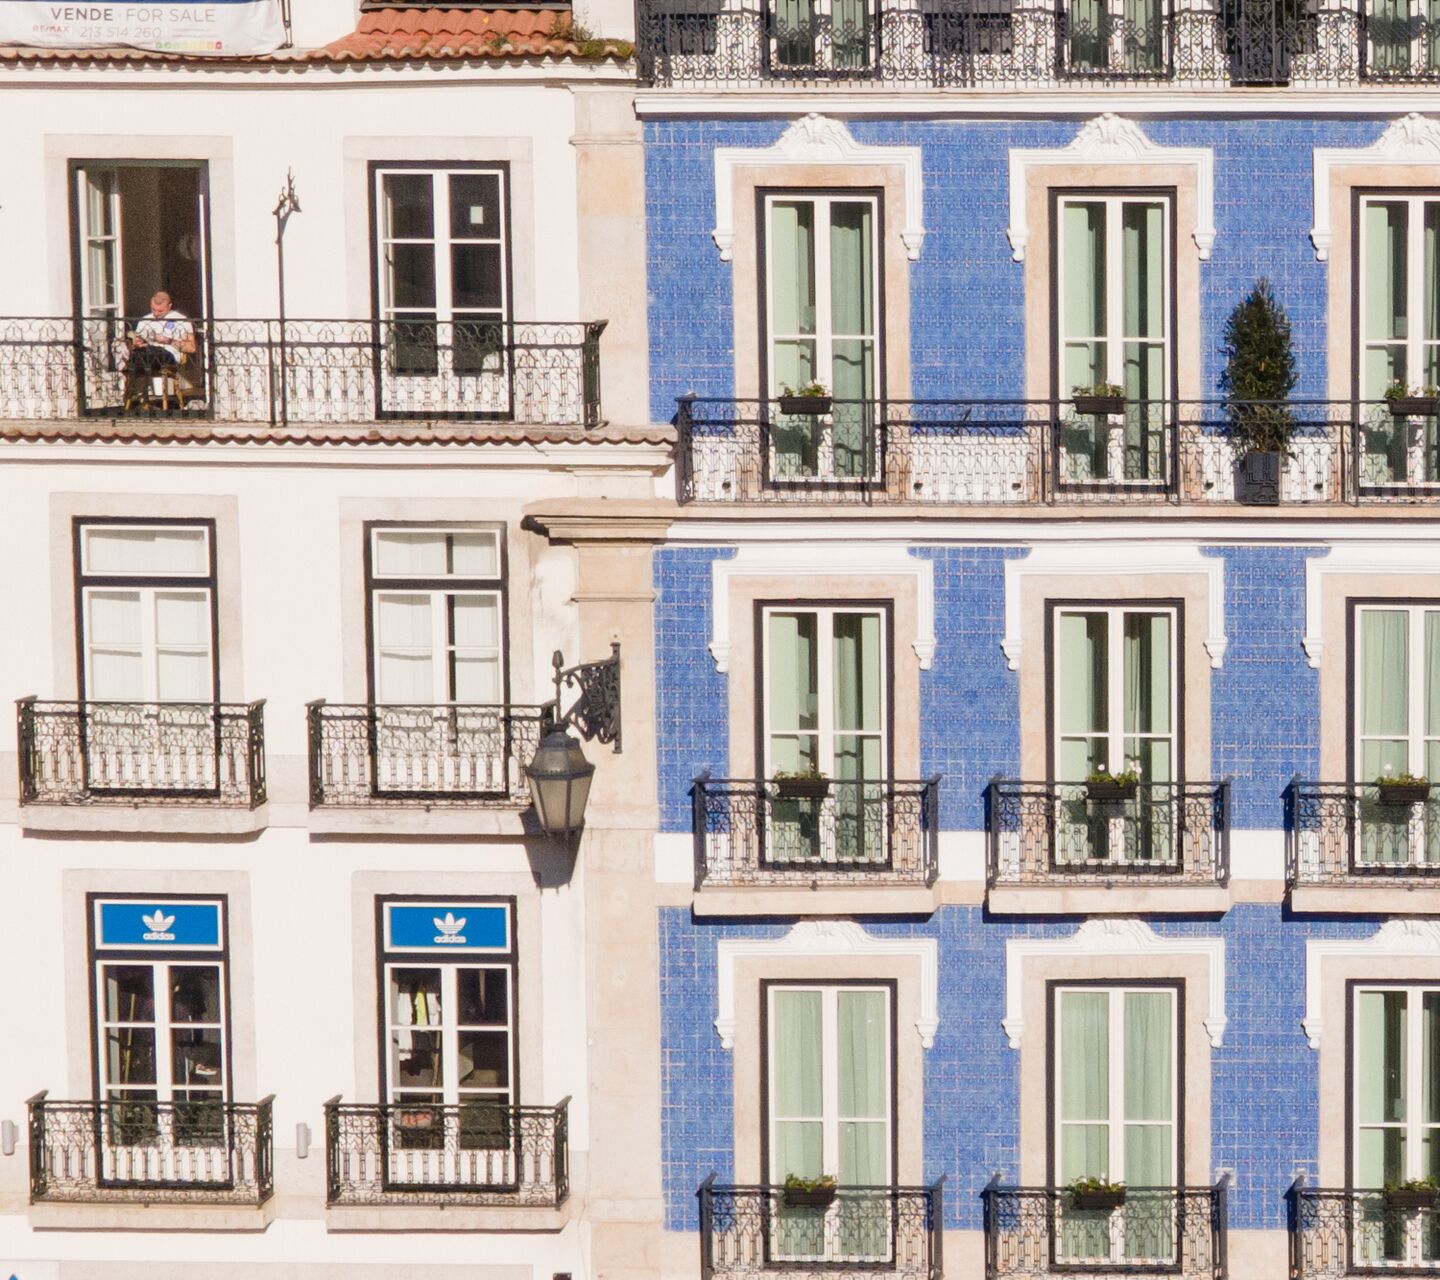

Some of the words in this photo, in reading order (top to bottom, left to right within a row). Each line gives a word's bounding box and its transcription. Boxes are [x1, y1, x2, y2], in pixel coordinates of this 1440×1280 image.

[51, 7, 114, 21] VENDE
[126, 8, 163, 22] FOR
[169, 8, 216, 23] SALE
[80, 26, 102, 39] 213
[134, 27, 162, 39] 260
